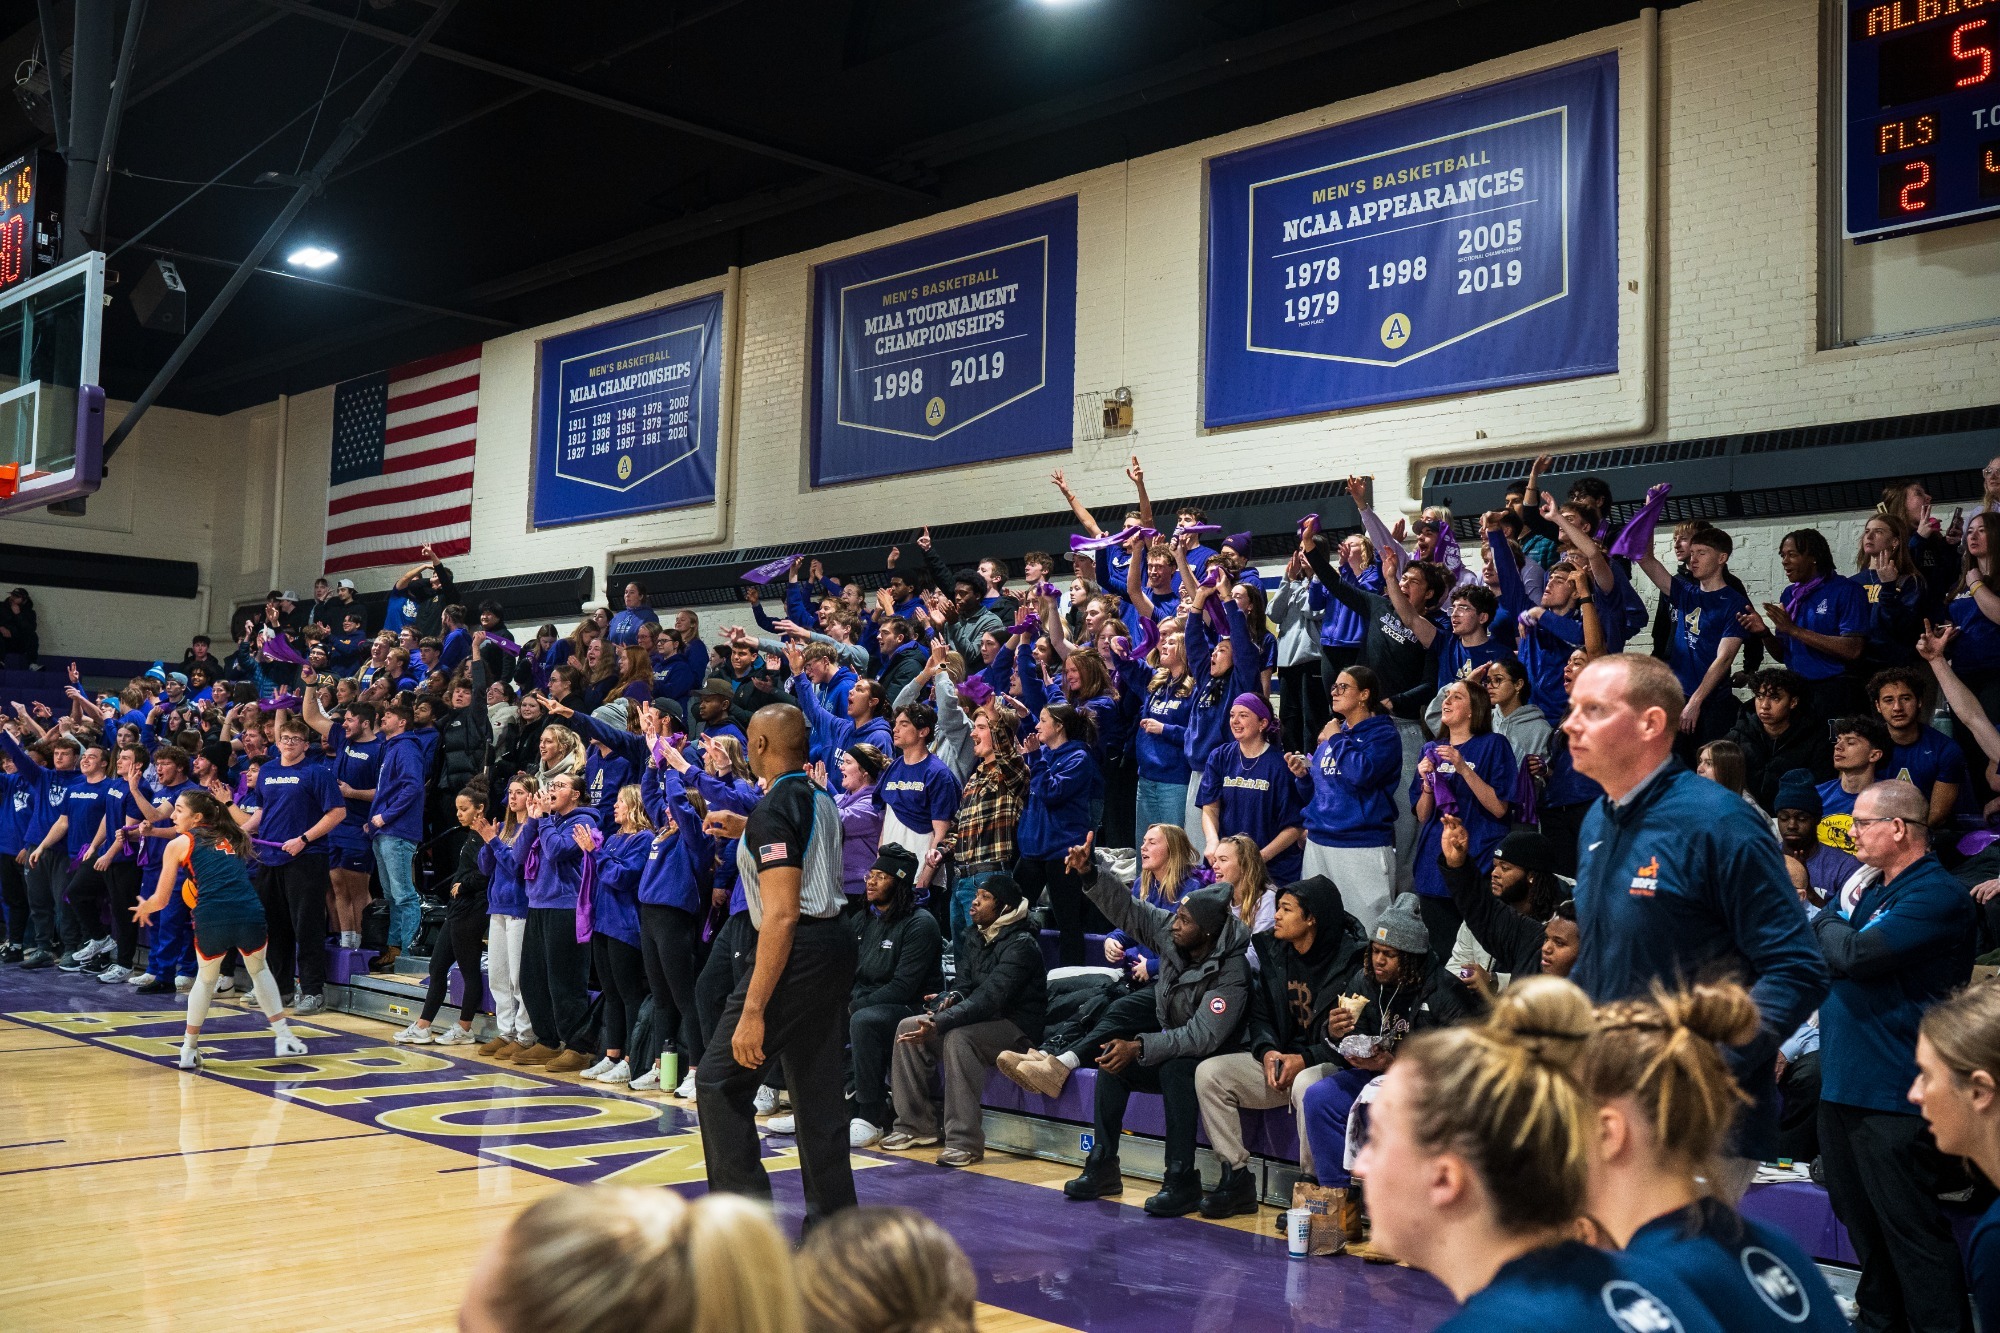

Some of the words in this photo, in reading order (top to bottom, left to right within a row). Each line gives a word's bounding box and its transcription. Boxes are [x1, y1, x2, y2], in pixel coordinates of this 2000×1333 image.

[1952, 19, 1992, 86] 5
[1881, 115, 1933, 153] FLS
[1312, 179, 1366, 205] MEN'S
[1373, 150, 1491, 191] BASKETBALL
[1900, 160, 1930, 211] 2
[1282, 210, 1343, 242] NCAA
[1346, 167, 1525, 228] APPEARANCES
[1457, 218, 1522, 255] 2005
[882, 287, 919, 307] MEN'S
[922, 267, 999, 297] BASKETBALL
[1285, 256, 1340, 290] 1978
[1368, 255, 1427, 290] 1998
[1457, 259, 1522, 295] 2019
[864, 311, 904, 336] MIAA
[906, 283, 1019, 326] TOURNAMENT
[1284, 290, 1339, 323] 1979
[875, 309, 1005, 355] CHAMPIONSHIPS
[1386, 318, 1406, 341] A
[589, 362, 615, 378] MEN'S
[616, 349, 671, 371] BASKETBALL
[873, 367, 924, 402] 1998
[949, 351, 1005, 387] 2019
[569, 381, 598, 404] MIAA
[598, 361, 691, 397] CHAMPIONSHIPS
[567, 431, 587, 447] 1912
[591, 426, 611, 442] 1936
[616, 421, 636, 436] 1951
[642, 416, 662, 431] 1979
[668, 410, 689, 426] 2005
[568, 417, 587, 432] 1911
[592, 412, 611, 427] 1929
[617, 406, 637, 422] 1948
[642, 401, 662, 416] 1978
[669, 395, 690, 411] 2003
[928, 401, 942, 419] A
[566, 446, 586, 461] 1927
[591, 441, 610, 456] 1946
[616, 435, 636, 451] 1957
[641, 431, 661, 446] 1981
[667, 425, 688, 441] 2020
[1381, 624, 1406, 645] SOCCER
